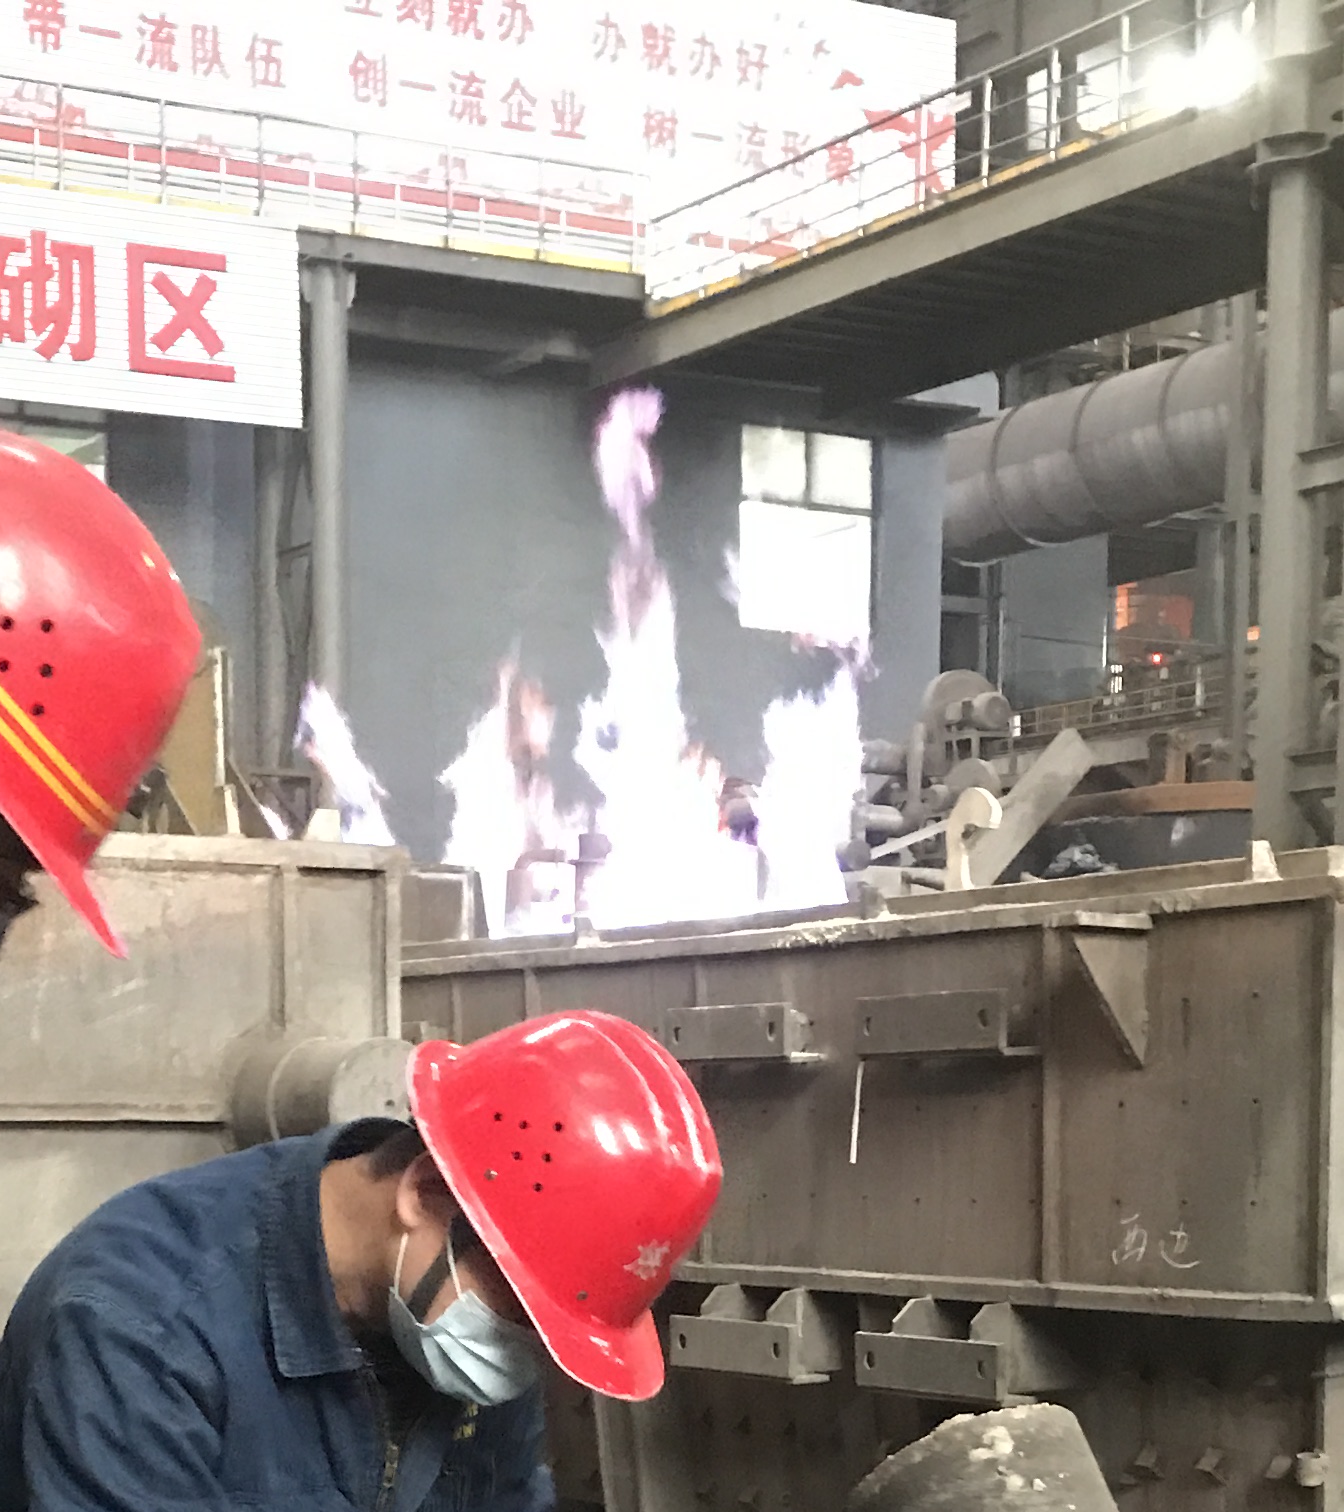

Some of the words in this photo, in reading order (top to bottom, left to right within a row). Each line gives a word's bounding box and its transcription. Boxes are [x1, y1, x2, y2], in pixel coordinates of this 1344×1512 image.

[23, 0, 285, 88] 带一流队伍
[348, 50, 587, 140] 创一流企业
[592, 11, 768, 91] 办就办好
